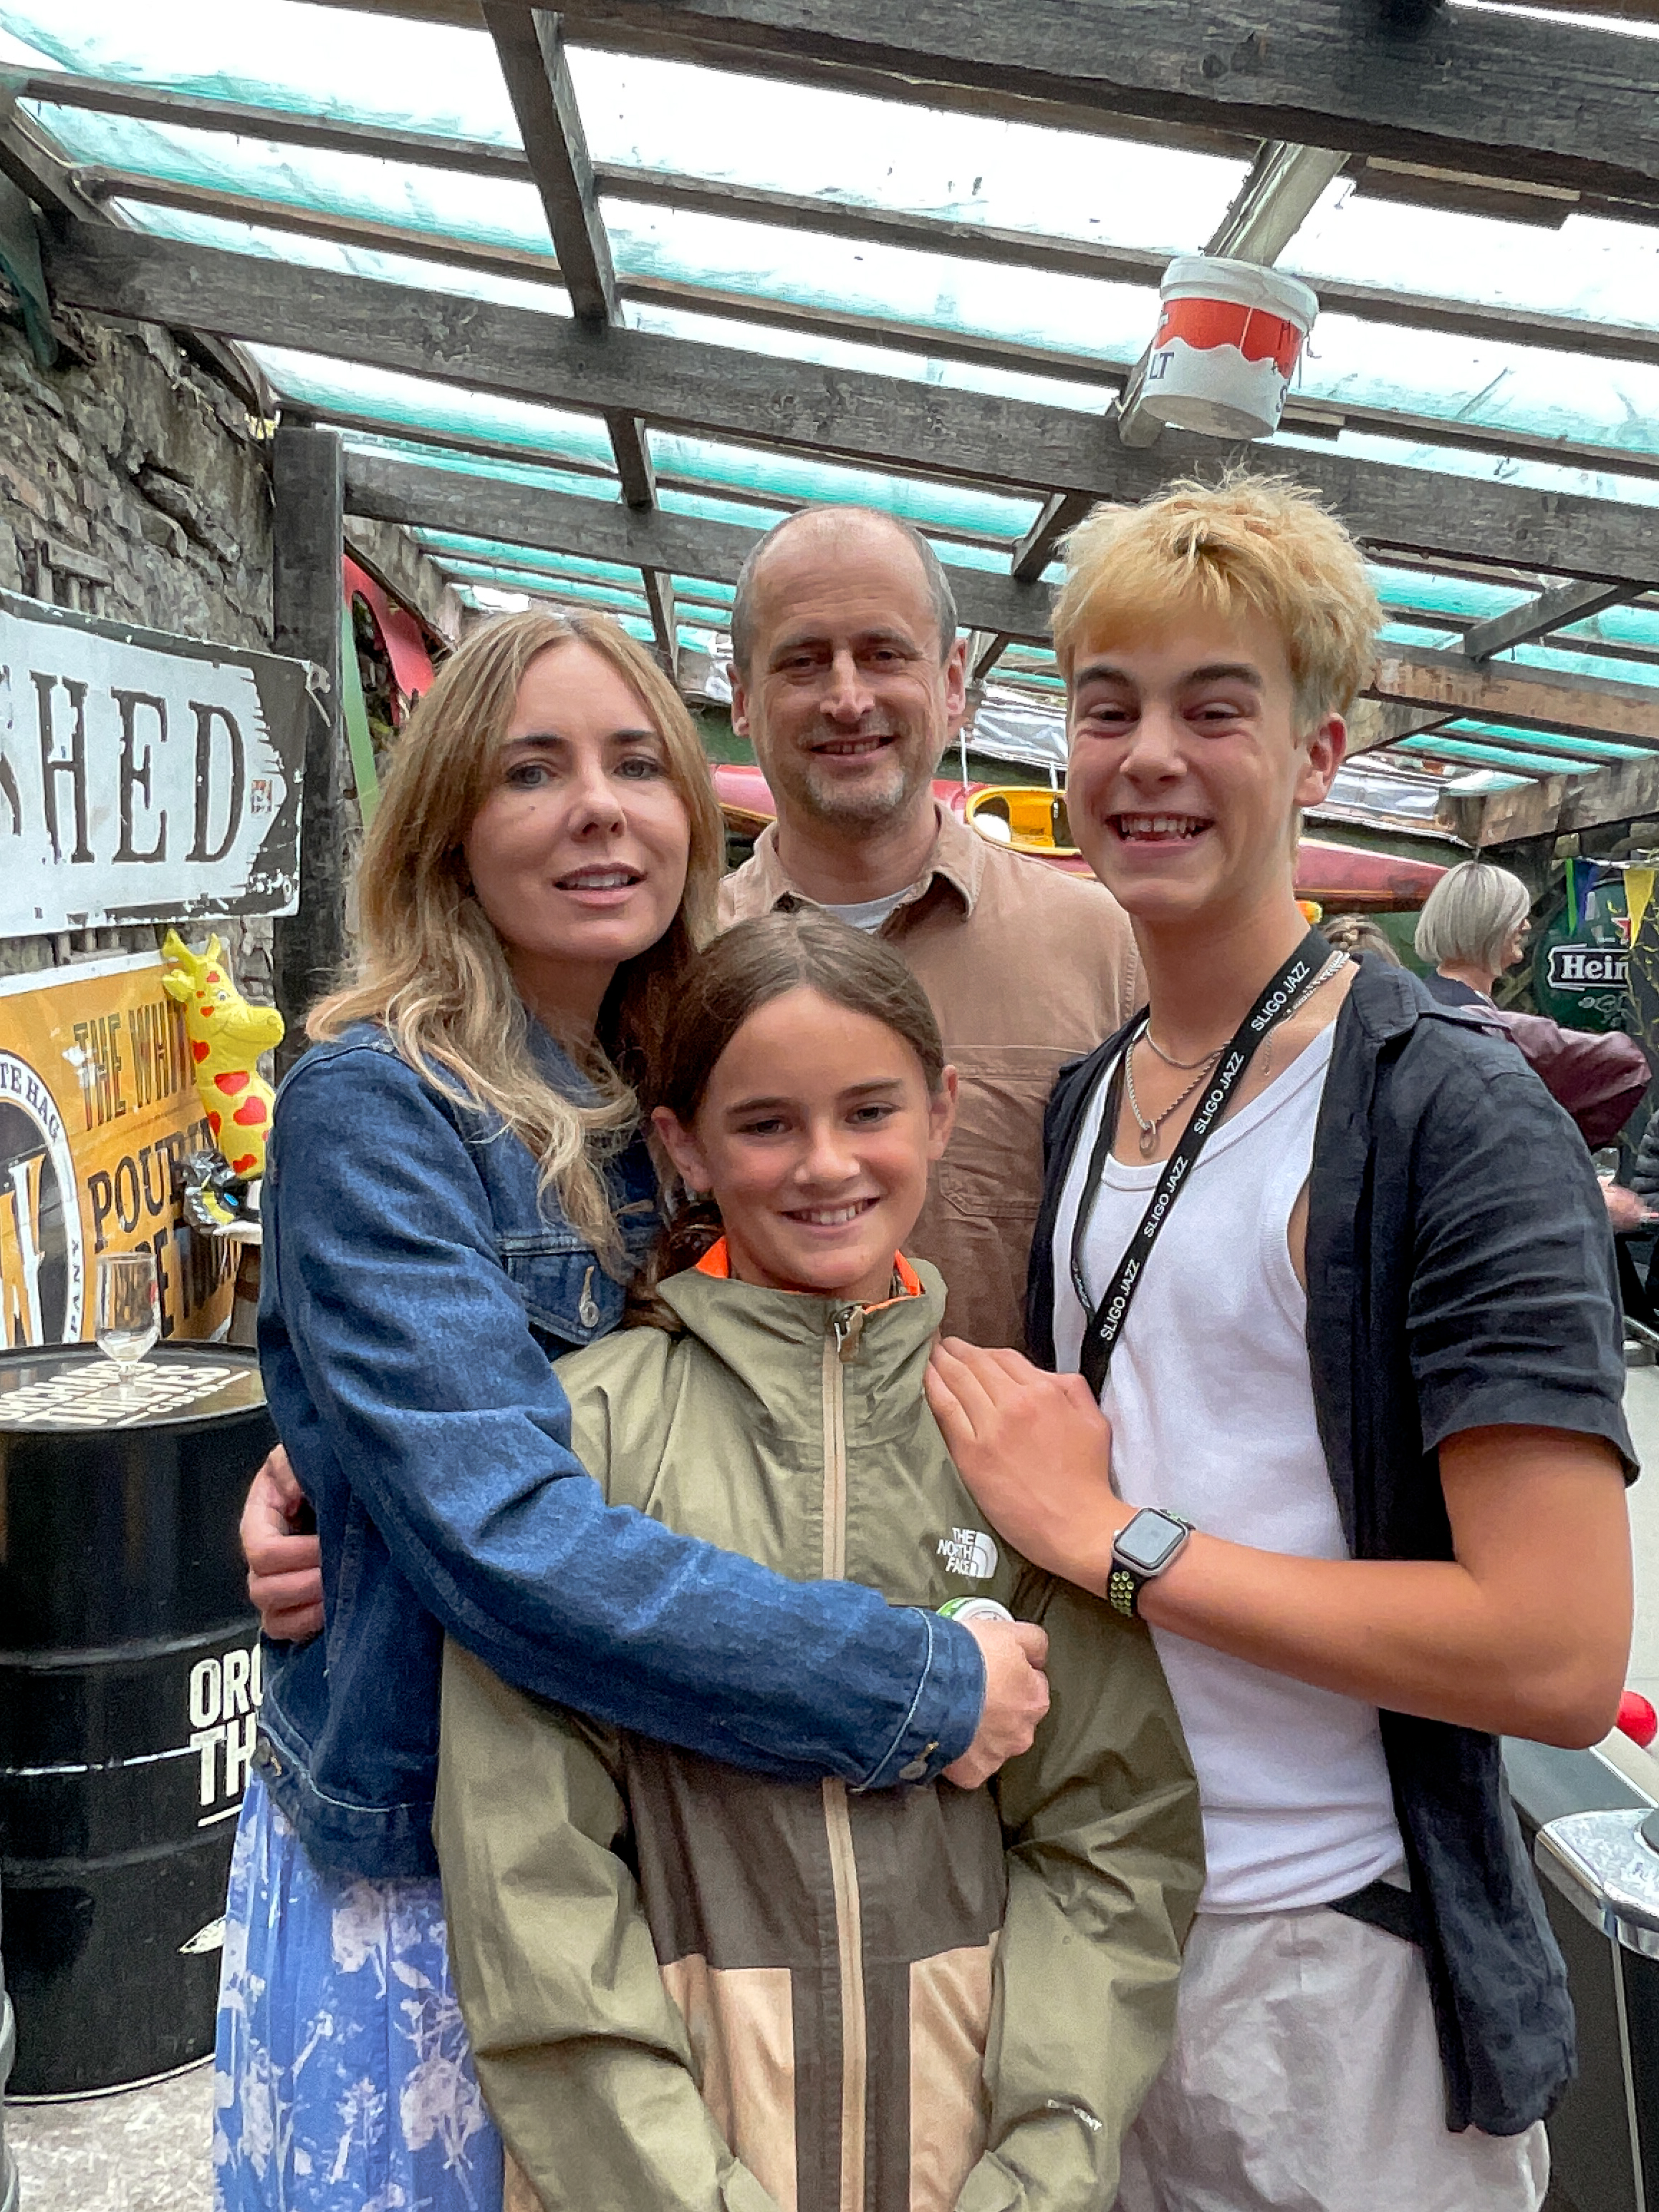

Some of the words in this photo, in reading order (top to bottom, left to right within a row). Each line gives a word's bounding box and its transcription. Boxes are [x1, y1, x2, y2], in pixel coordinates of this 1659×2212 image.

[1251, 991, 1287, 1032] SLIGO
[1282, 961, 1311, 994] JAZZ
[26, 1075, 59, 1143] HAG
[73, 1012, 127, 1132] THE
[1193, 1090, 1224, 1135] SLIGO
[1216, 1052, 1245, 1090] JAZZ
[1143, 1193, 1169, 1238] SLIGO
[1166, 1155, 1189, 1193] JAZZ
[1100, 1297, 1126, 1341] SLIGO
[1121, 1258, 1140, 1297] JAZZ
[946, 1556, 971, 1575] FACE
[952, 1527, 976, 1545] THE
